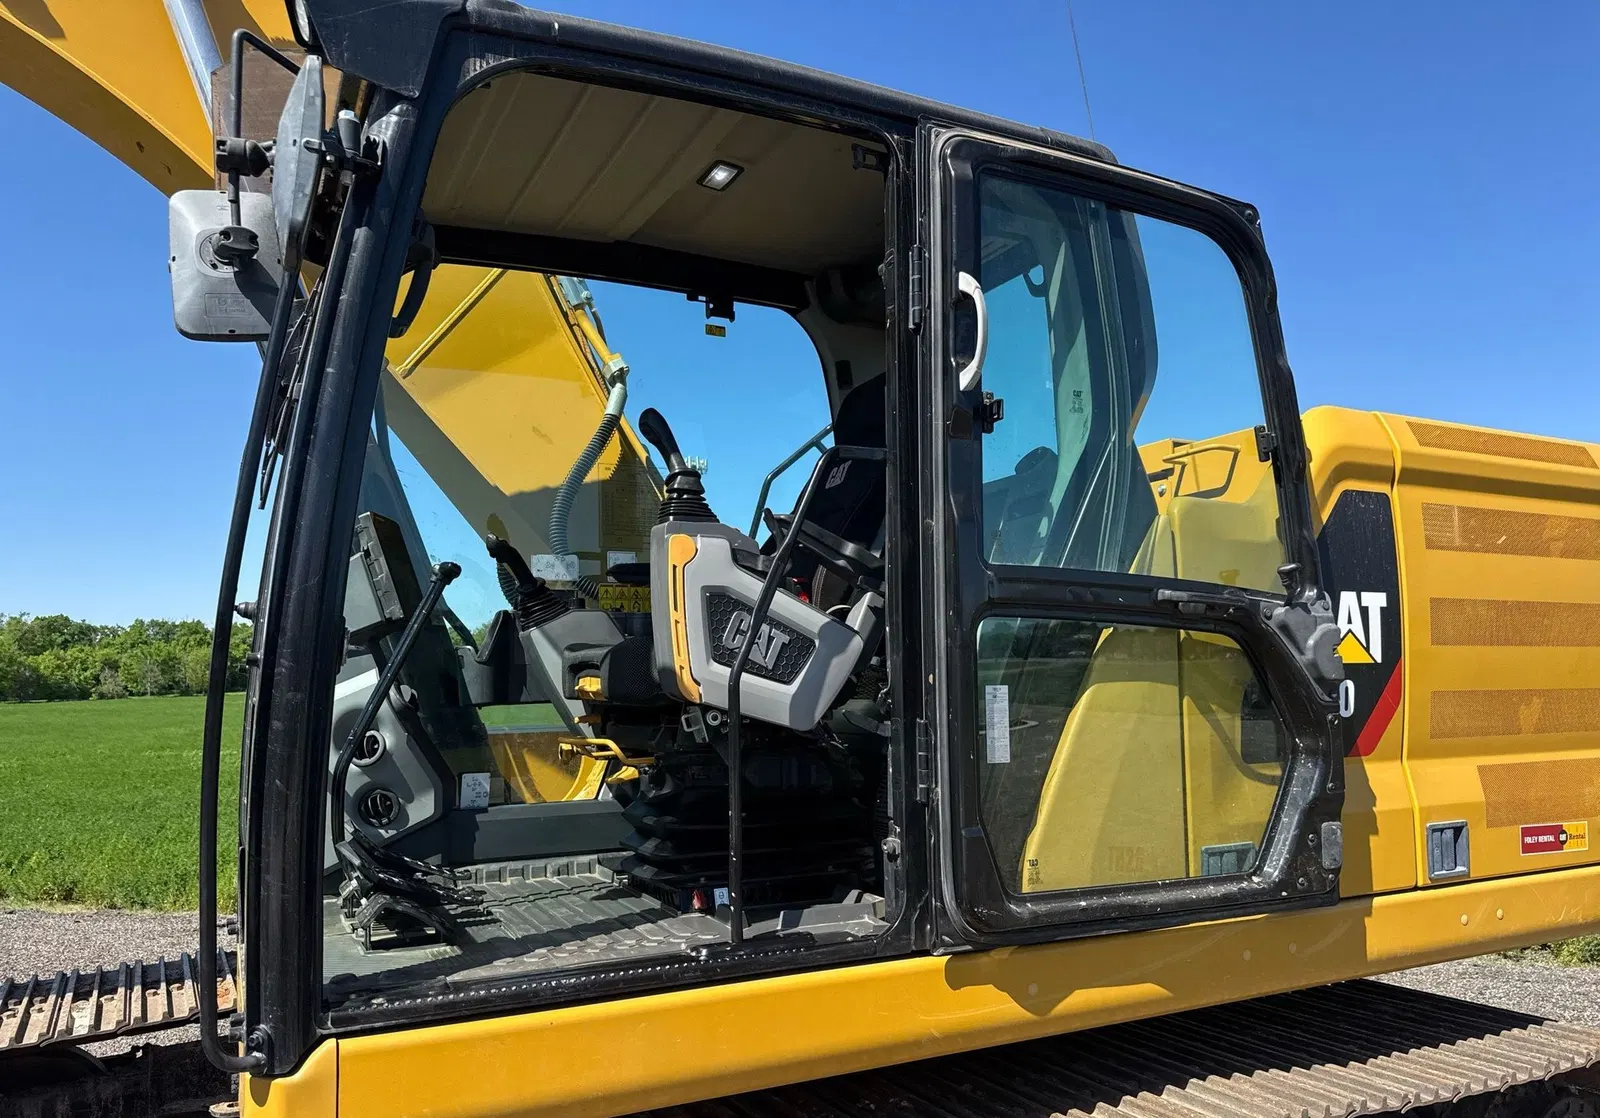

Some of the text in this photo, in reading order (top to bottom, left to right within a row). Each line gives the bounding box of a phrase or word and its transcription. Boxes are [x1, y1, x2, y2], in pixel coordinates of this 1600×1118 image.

[723, 610, 790, 670] CAT
[1337, 590, 1387, 664] AT
[1524, 834, 1555, 844] FOLEY RENTAL
[1569, 832, 1586, 840] Rental
